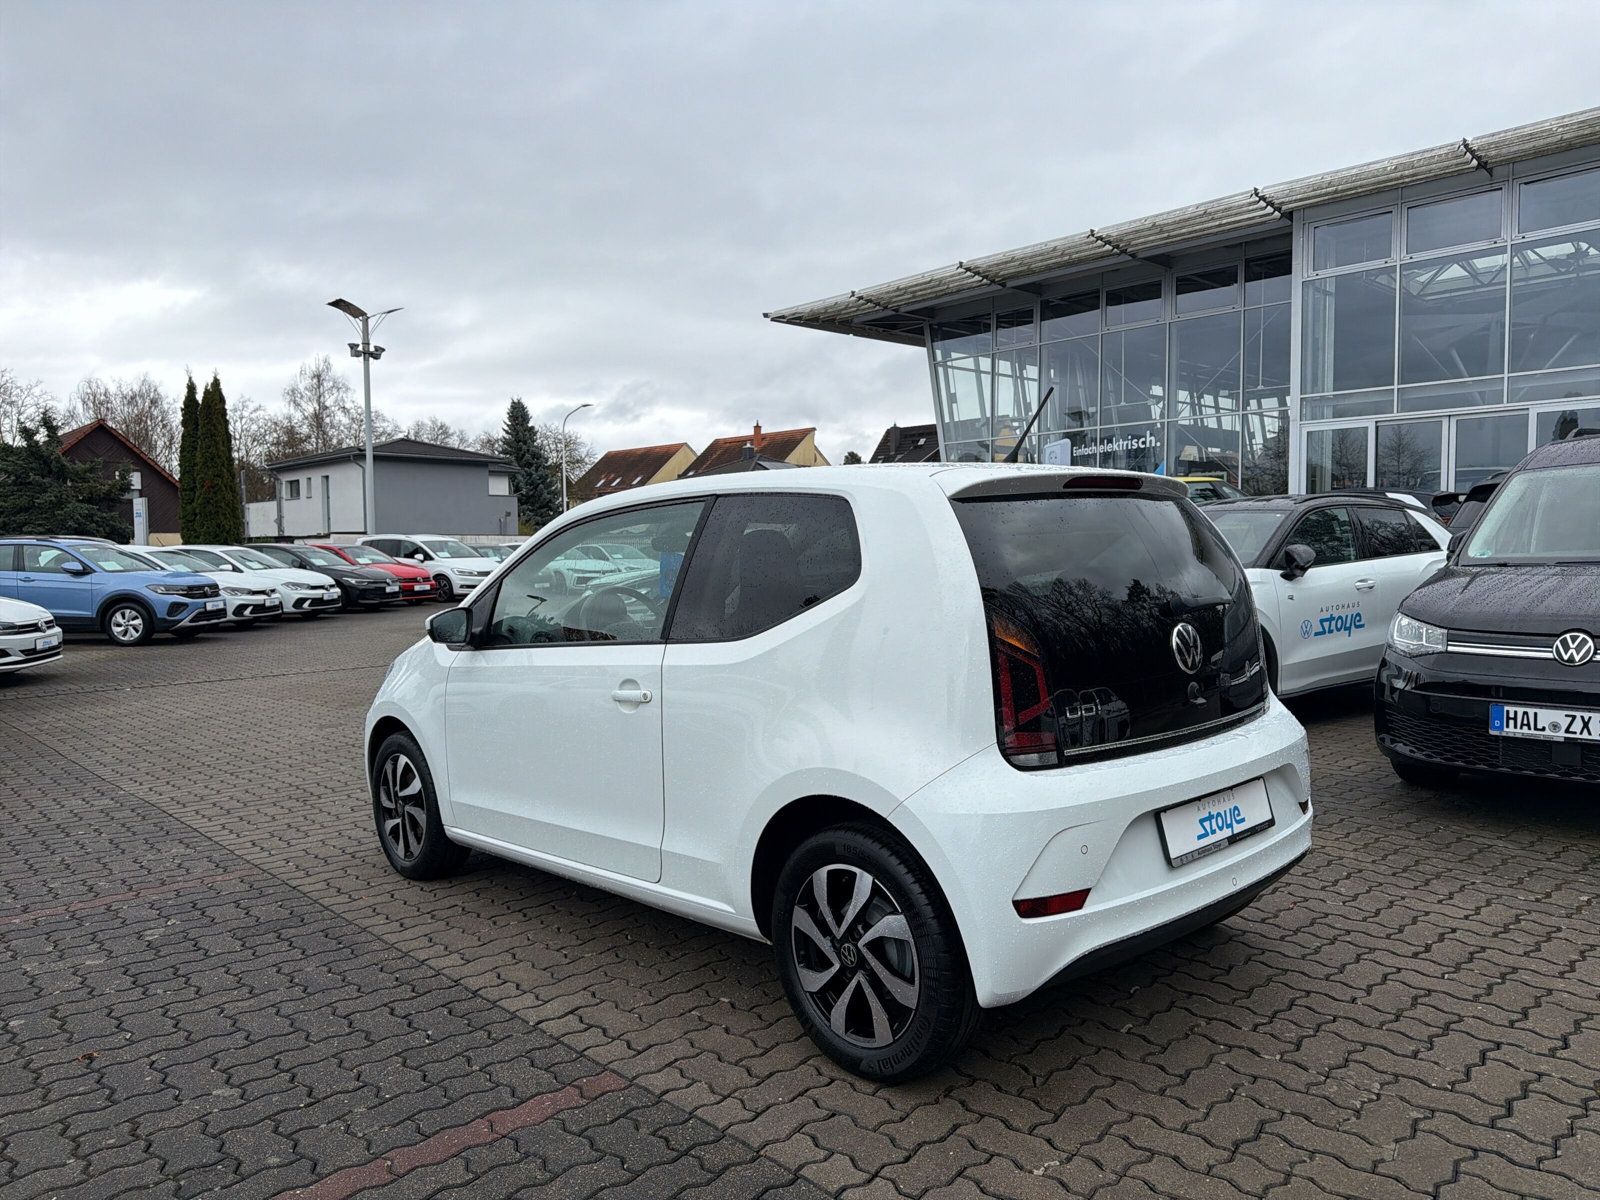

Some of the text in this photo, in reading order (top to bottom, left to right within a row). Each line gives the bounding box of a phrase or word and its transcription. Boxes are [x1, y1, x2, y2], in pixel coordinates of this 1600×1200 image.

[1073, 430, 1161, 456] Einfach elektrisch.
[1320, 601, 1360, 612] AUTOHAUS
[1552, 632, 1594, 666] VW
[1505, 709, 1546, 732] HAL
[1197, 793, 1235, 812] AUTOHAUS
